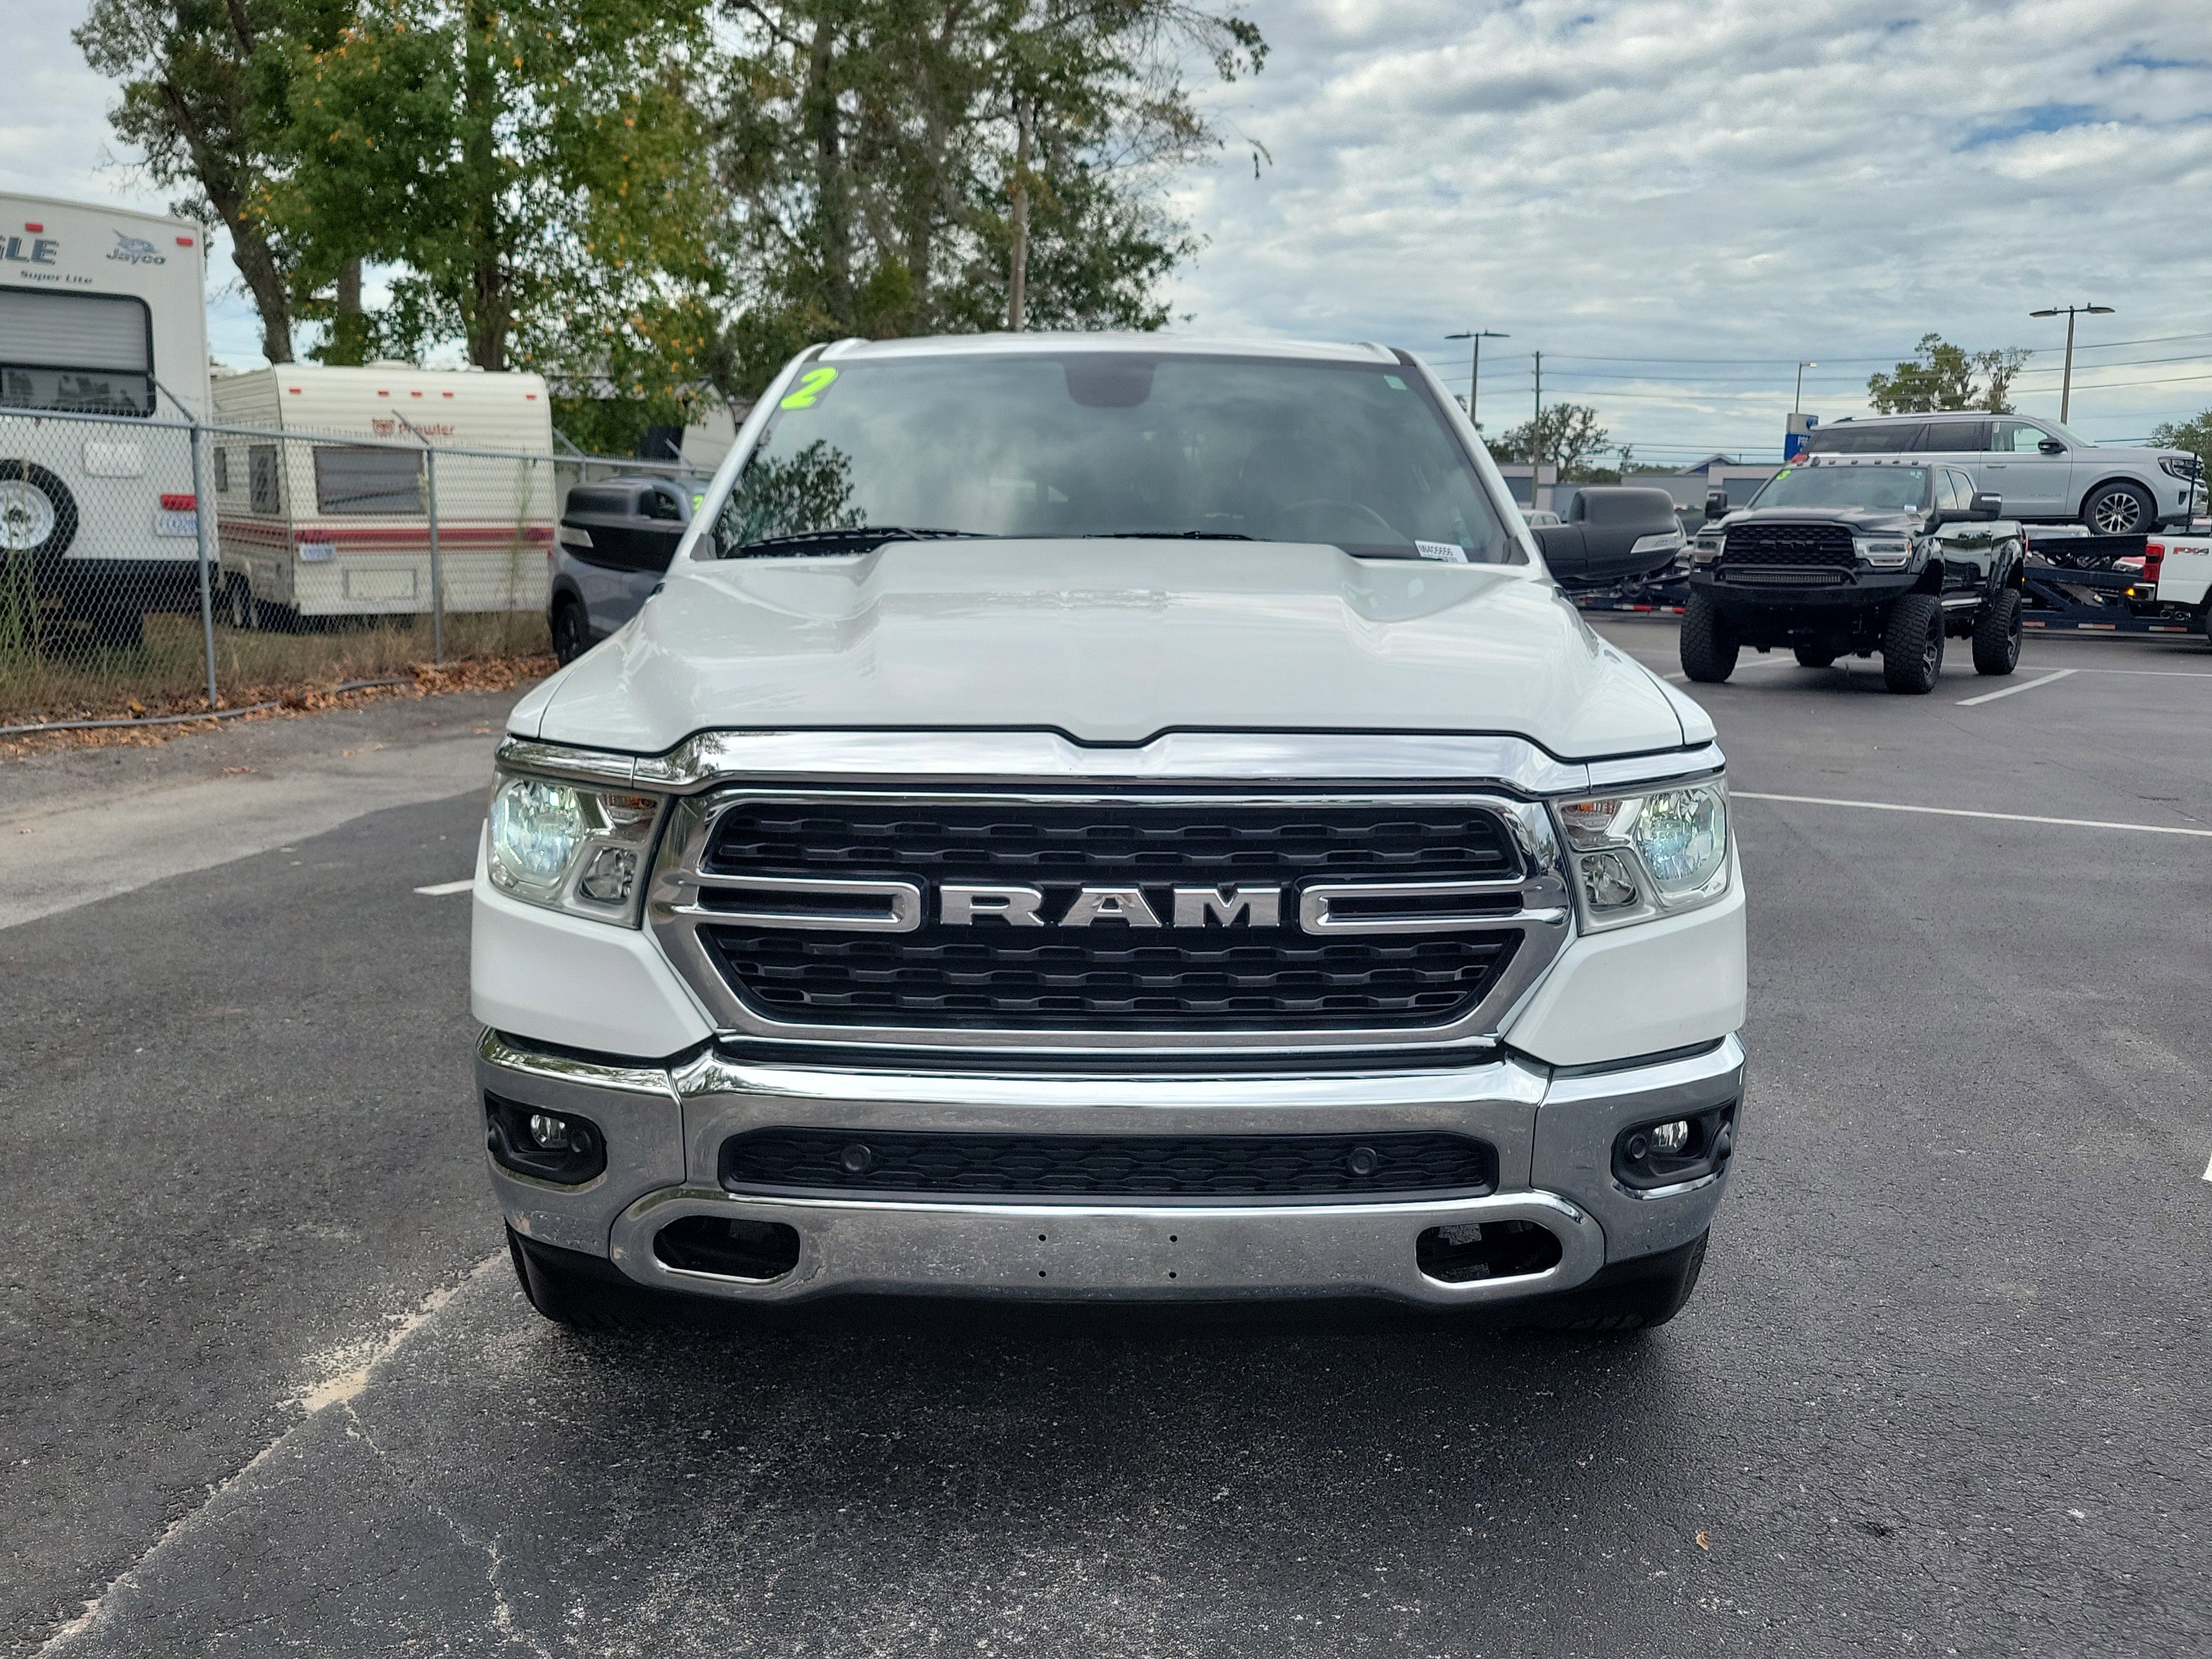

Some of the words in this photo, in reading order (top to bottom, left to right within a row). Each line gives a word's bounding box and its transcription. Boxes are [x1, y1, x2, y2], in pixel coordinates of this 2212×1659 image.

[106, 247, 166, 265] Jayco
[20, 270, 63, 282] Super
[65, 273, 93, 284] Lite
[780, 367, 839, 410] 2
[939, 884, 1282, 928] RAM
